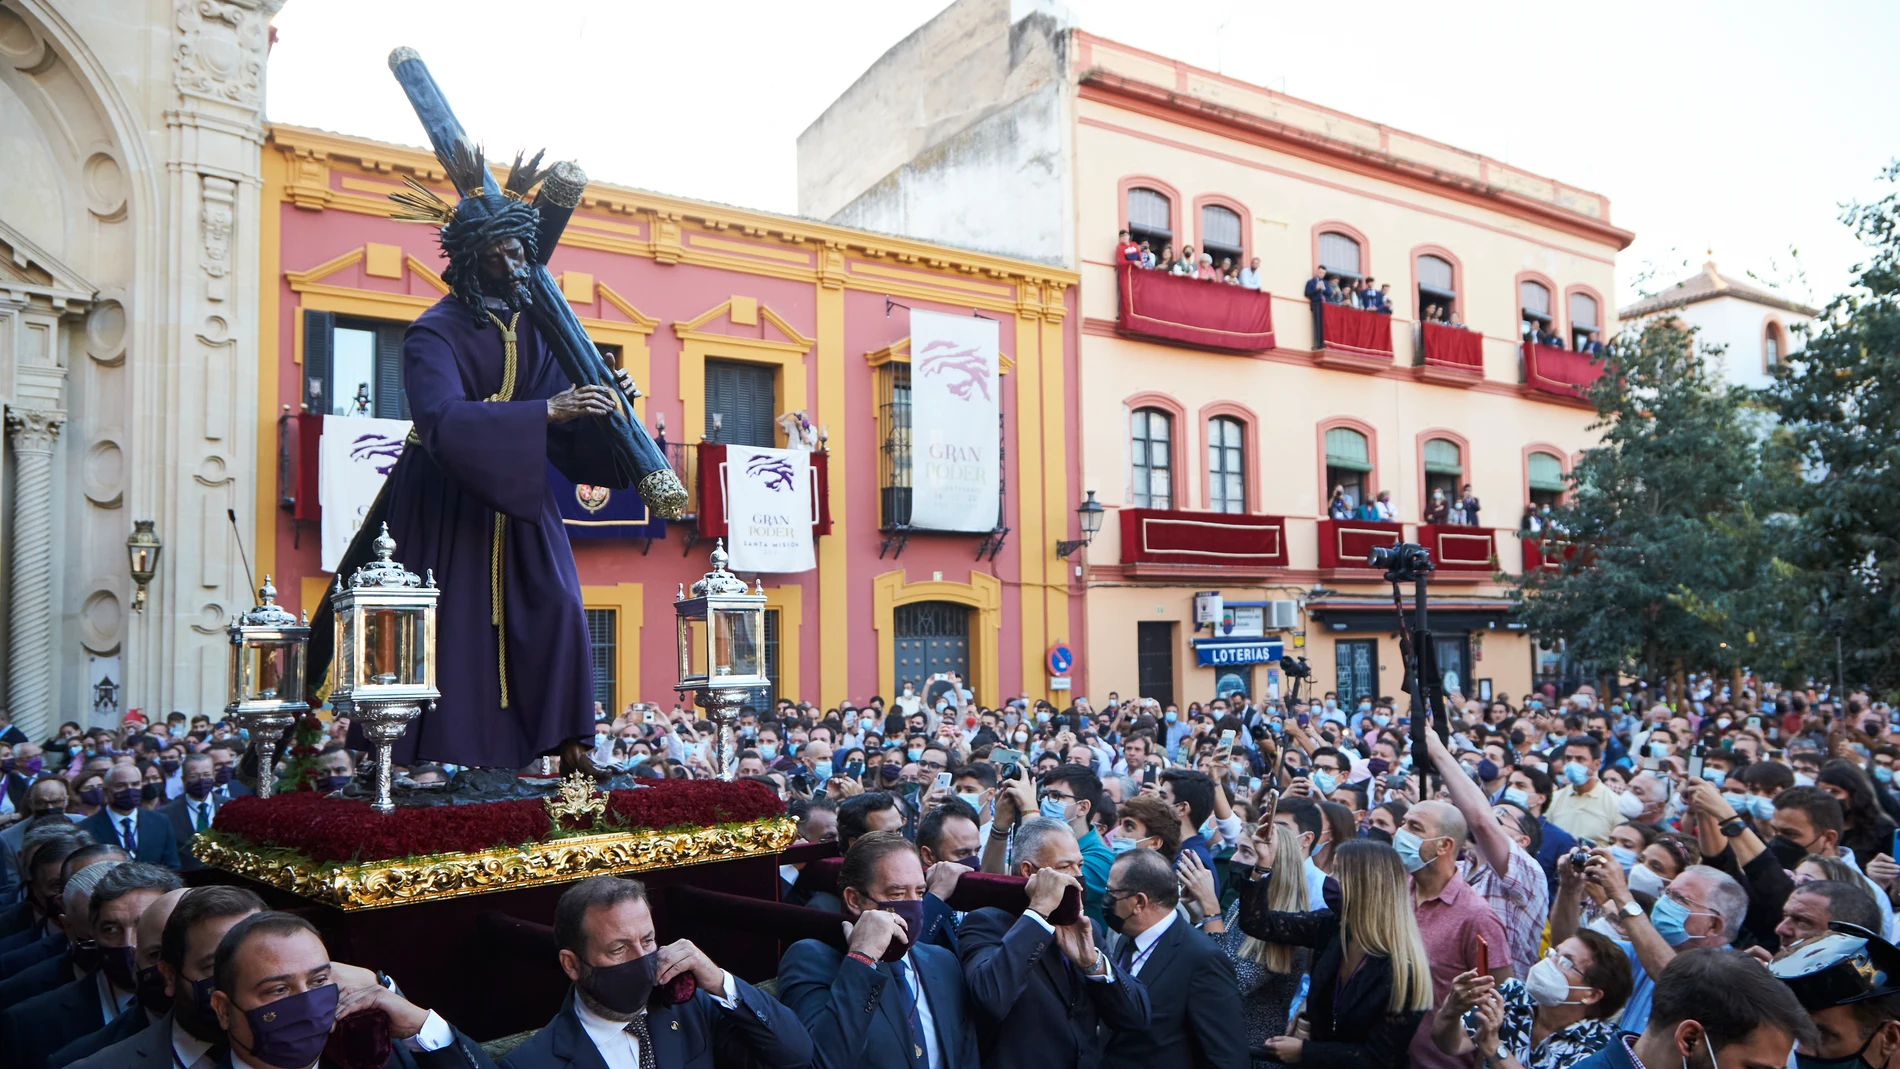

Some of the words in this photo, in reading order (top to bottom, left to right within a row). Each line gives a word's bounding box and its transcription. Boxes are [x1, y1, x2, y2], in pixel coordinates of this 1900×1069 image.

[929, 443, 982, 463] GRAN
[925, 461, 987, 486] PODER
[752, 513, 790, 526] GRAN
[749, 525, 795, 538] PODER
[1212, 647, 1270, 663] LOTERIAS
